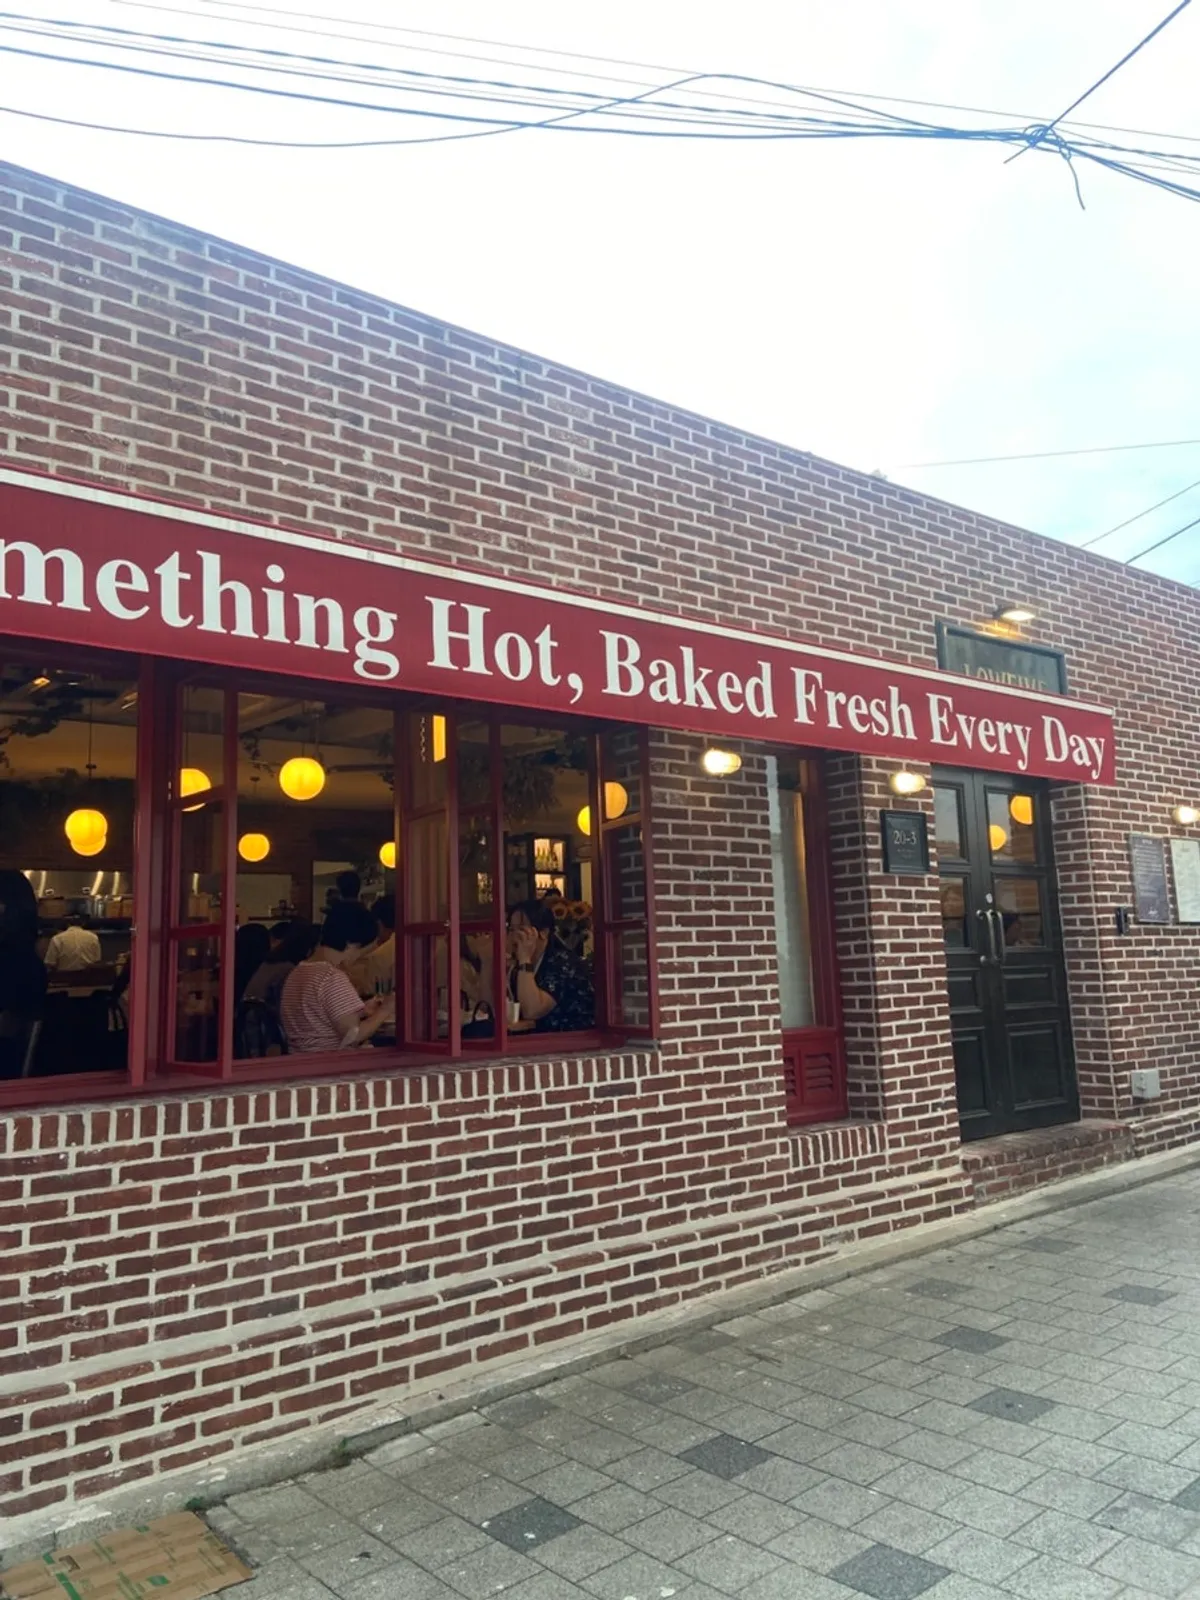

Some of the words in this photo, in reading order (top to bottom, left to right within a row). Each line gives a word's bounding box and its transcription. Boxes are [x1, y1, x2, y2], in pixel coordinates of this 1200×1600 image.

[425, 595, 584, 705] Hot,
[599, 630, 778, 718] Baked
[790, 666, 918, 741] Fresh
[926, 691, 1032, 771] Every
[1041, 714, 1106, 780] Day
[893, 830, 917, 845] 20-3
